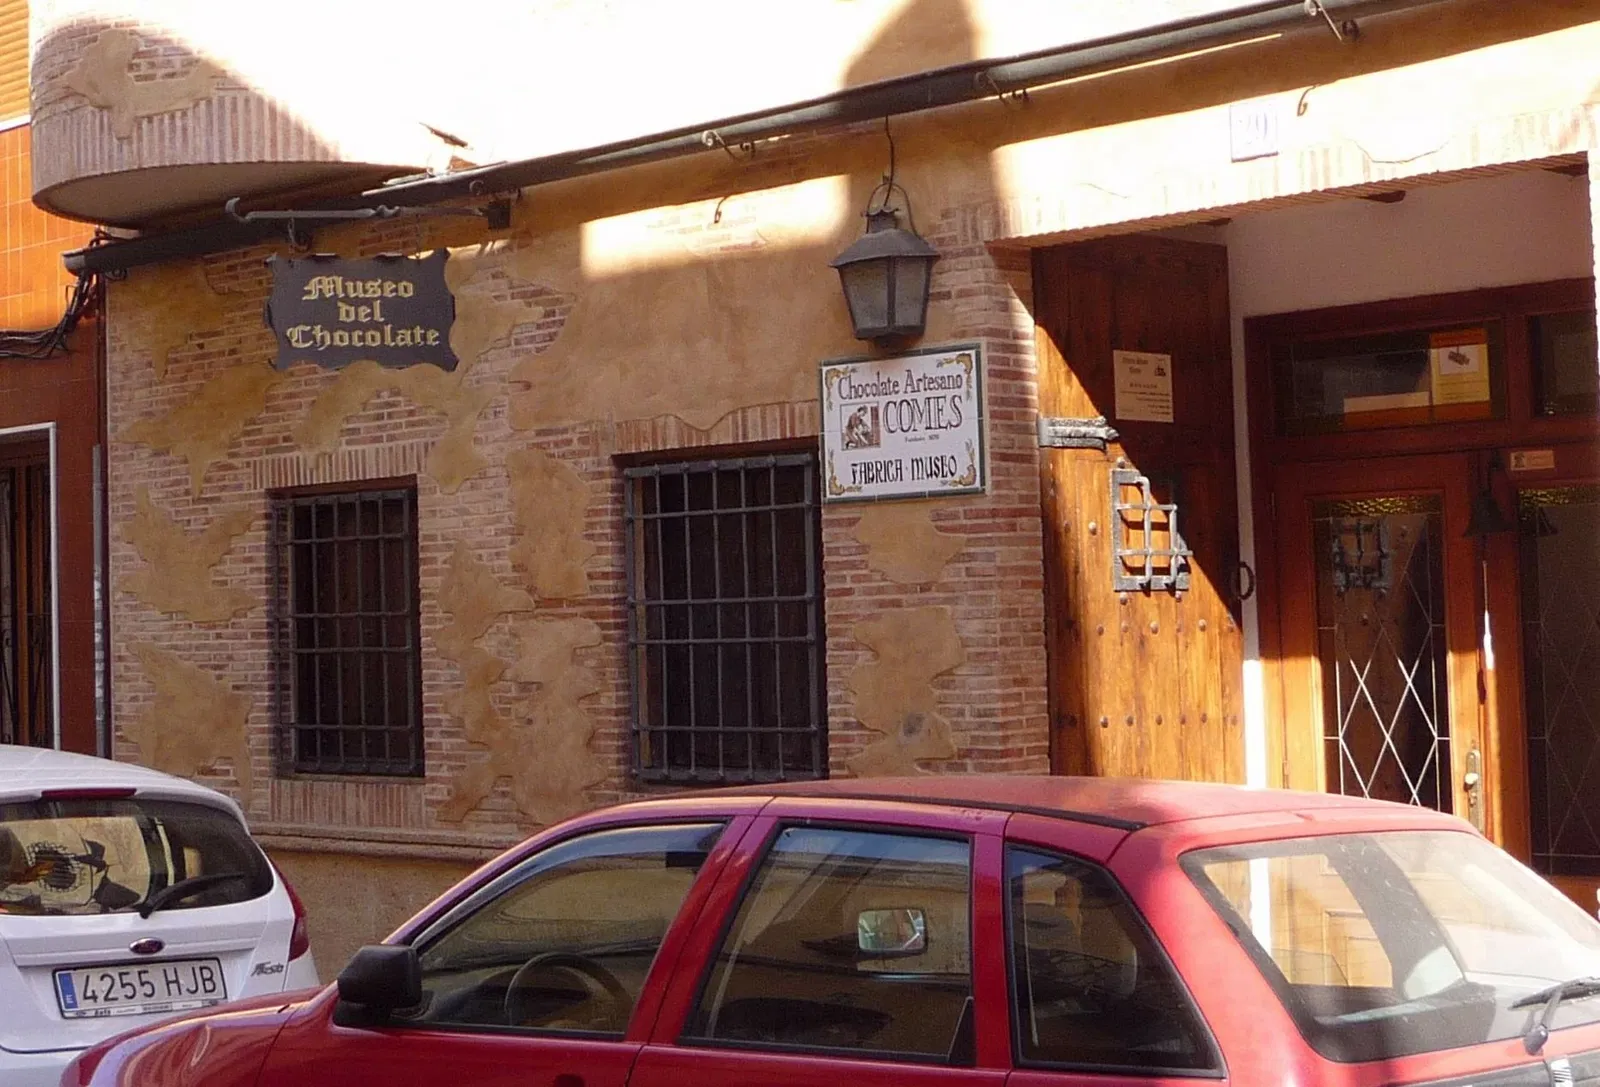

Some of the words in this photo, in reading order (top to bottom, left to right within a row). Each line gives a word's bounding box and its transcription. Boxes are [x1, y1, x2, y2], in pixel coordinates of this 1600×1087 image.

[302, 275, 414, 300] Museo
[336, 300, 385, 323] del
[286, 324, 440, 350] Chocolate
[838, 372, 900, 400] Chocolate
[903, 370, 963, 394] Artesano
[883, 395, 963, 434] COMES
[851, 459, 903, 485] FABRICA
[911, 455, 957, 481] MUSEO
[82, 970, 155, 1003] 4255
[163, 966, 217, 997] HJB
